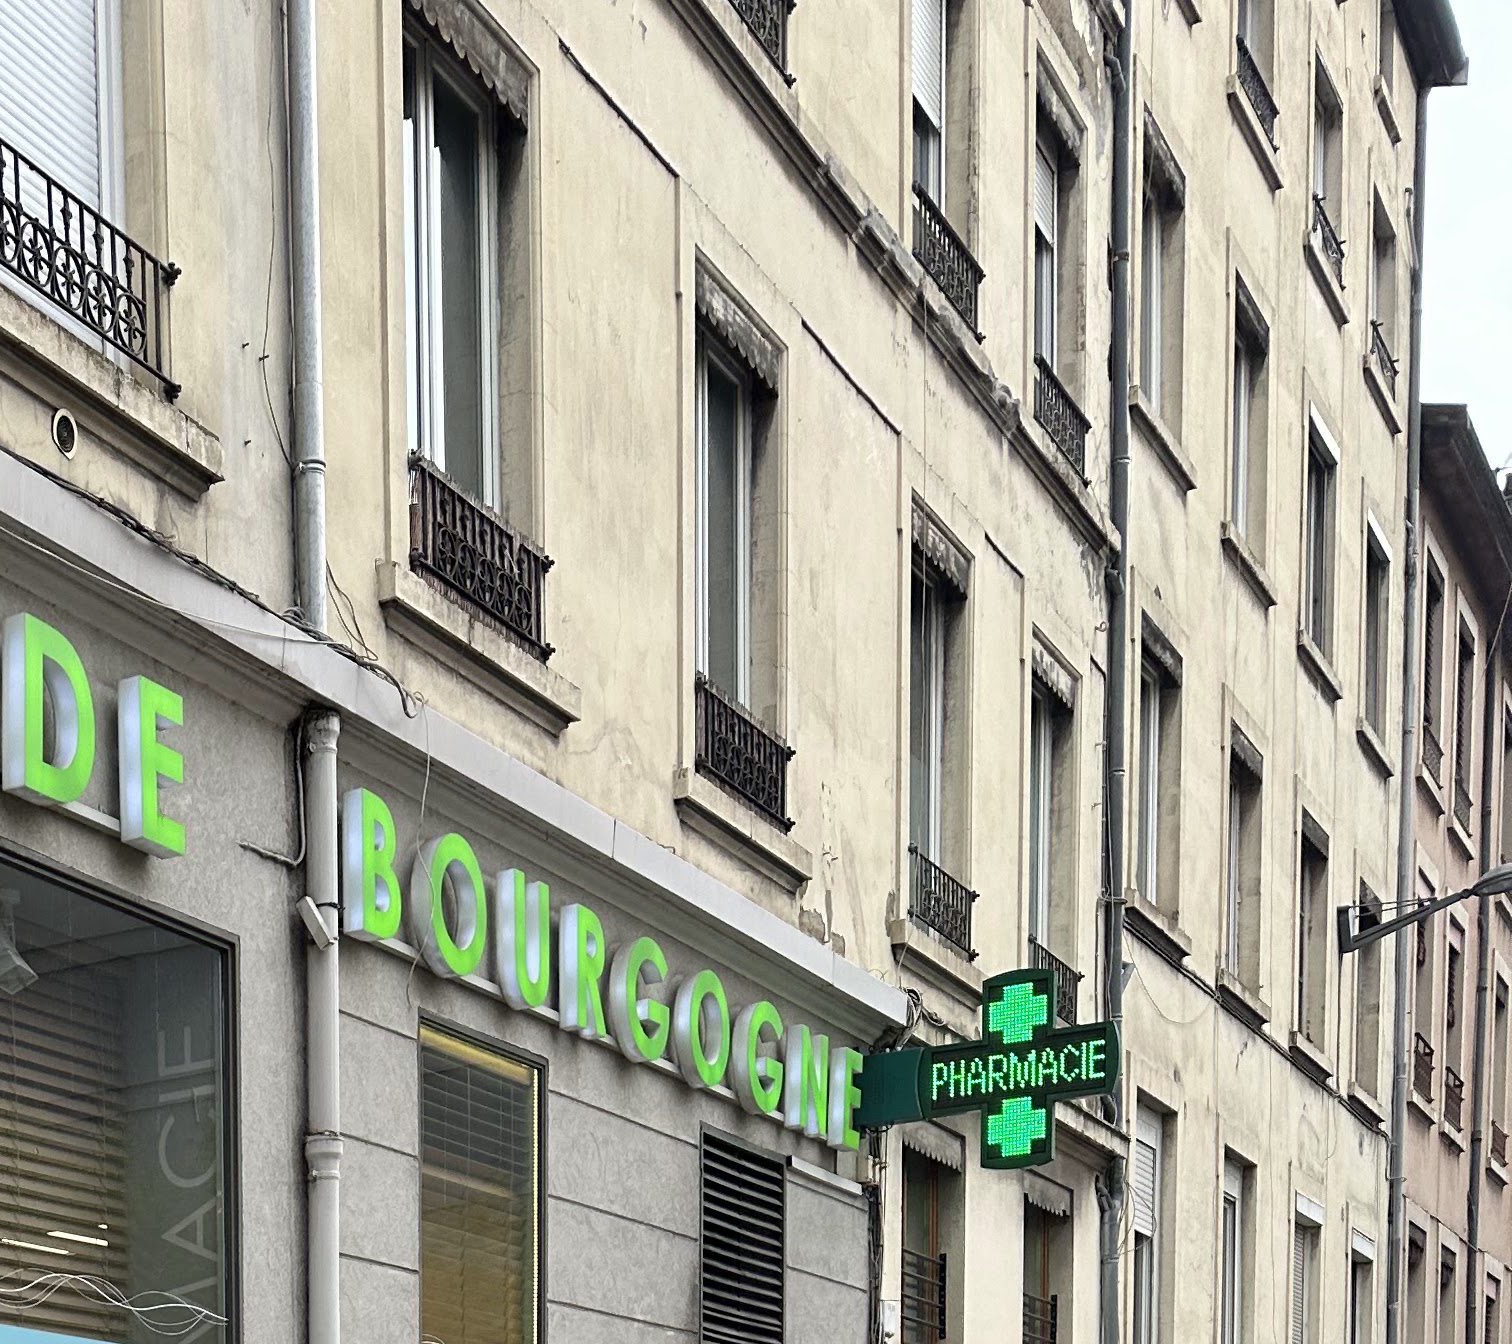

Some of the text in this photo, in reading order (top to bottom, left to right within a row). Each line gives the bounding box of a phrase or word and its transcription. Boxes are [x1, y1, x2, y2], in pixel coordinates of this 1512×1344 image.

[2, 611, 186, 859] DE
[342, 786, 864, 1151] BOURGOGNE
[932, 1039, 1106, 1101] PHARMACIE
